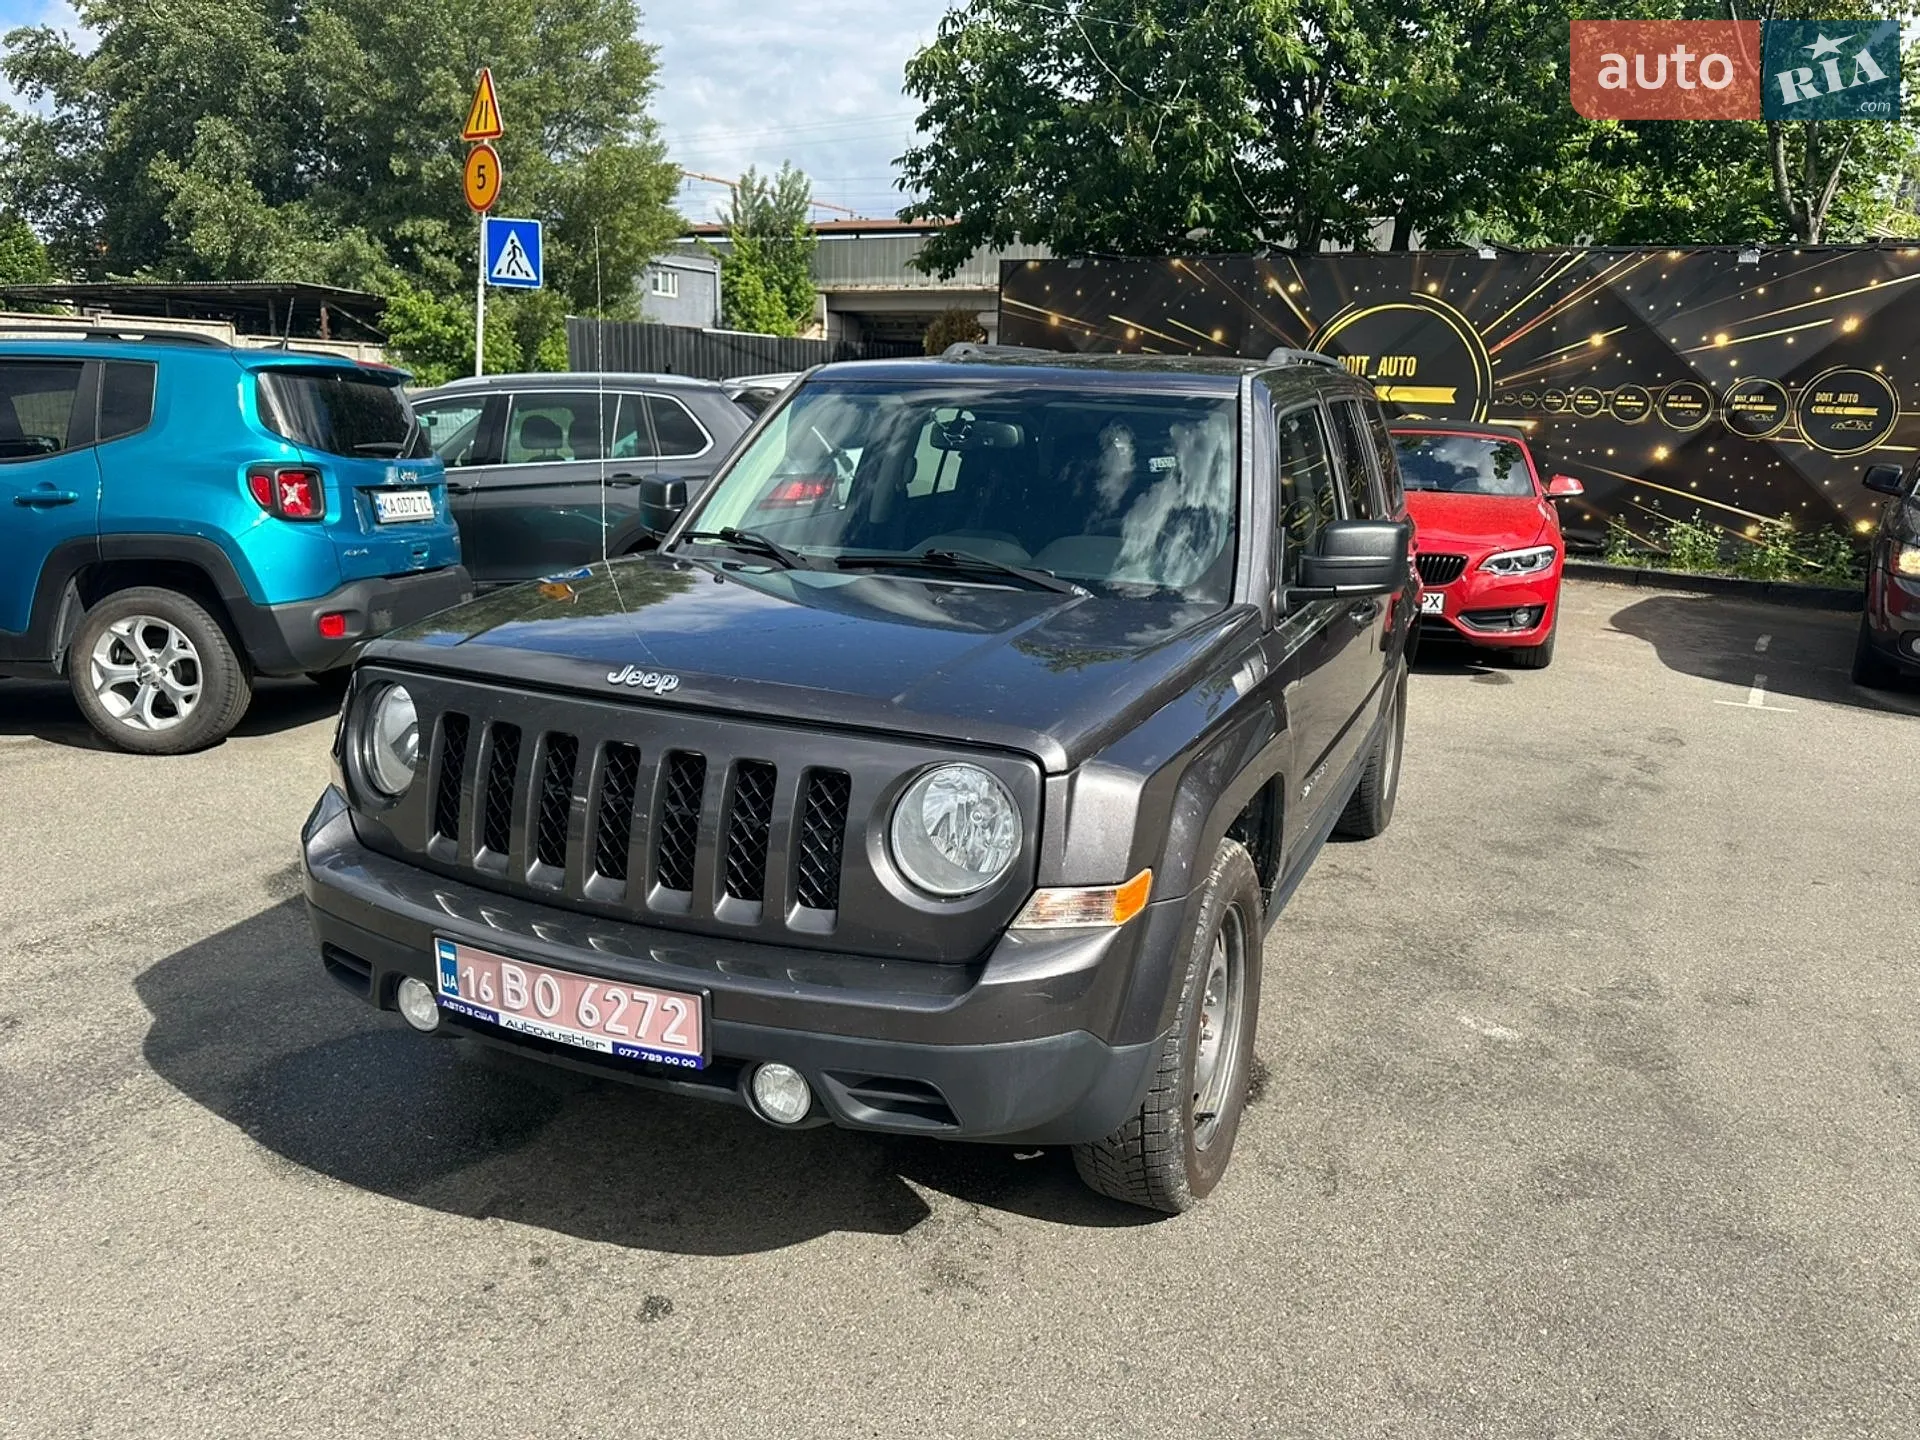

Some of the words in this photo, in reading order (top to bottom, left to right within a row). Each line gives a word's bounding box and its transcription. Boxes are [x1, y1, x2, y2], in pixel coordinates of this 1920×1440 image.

[477, 165, 487, 190] 5
[607, 664, 680, 695] Jeep
[442, 972, 459, 991] UA
[461, 966, 494, 1003] 16
[501, 962, 561, 1019] BO
[578, 983, 688, 1045] 6272
[618, 1047, 639, 1058] 077
[664, 1056, 679, 1065] 00
[681, 1058, 696, 1068] 00
